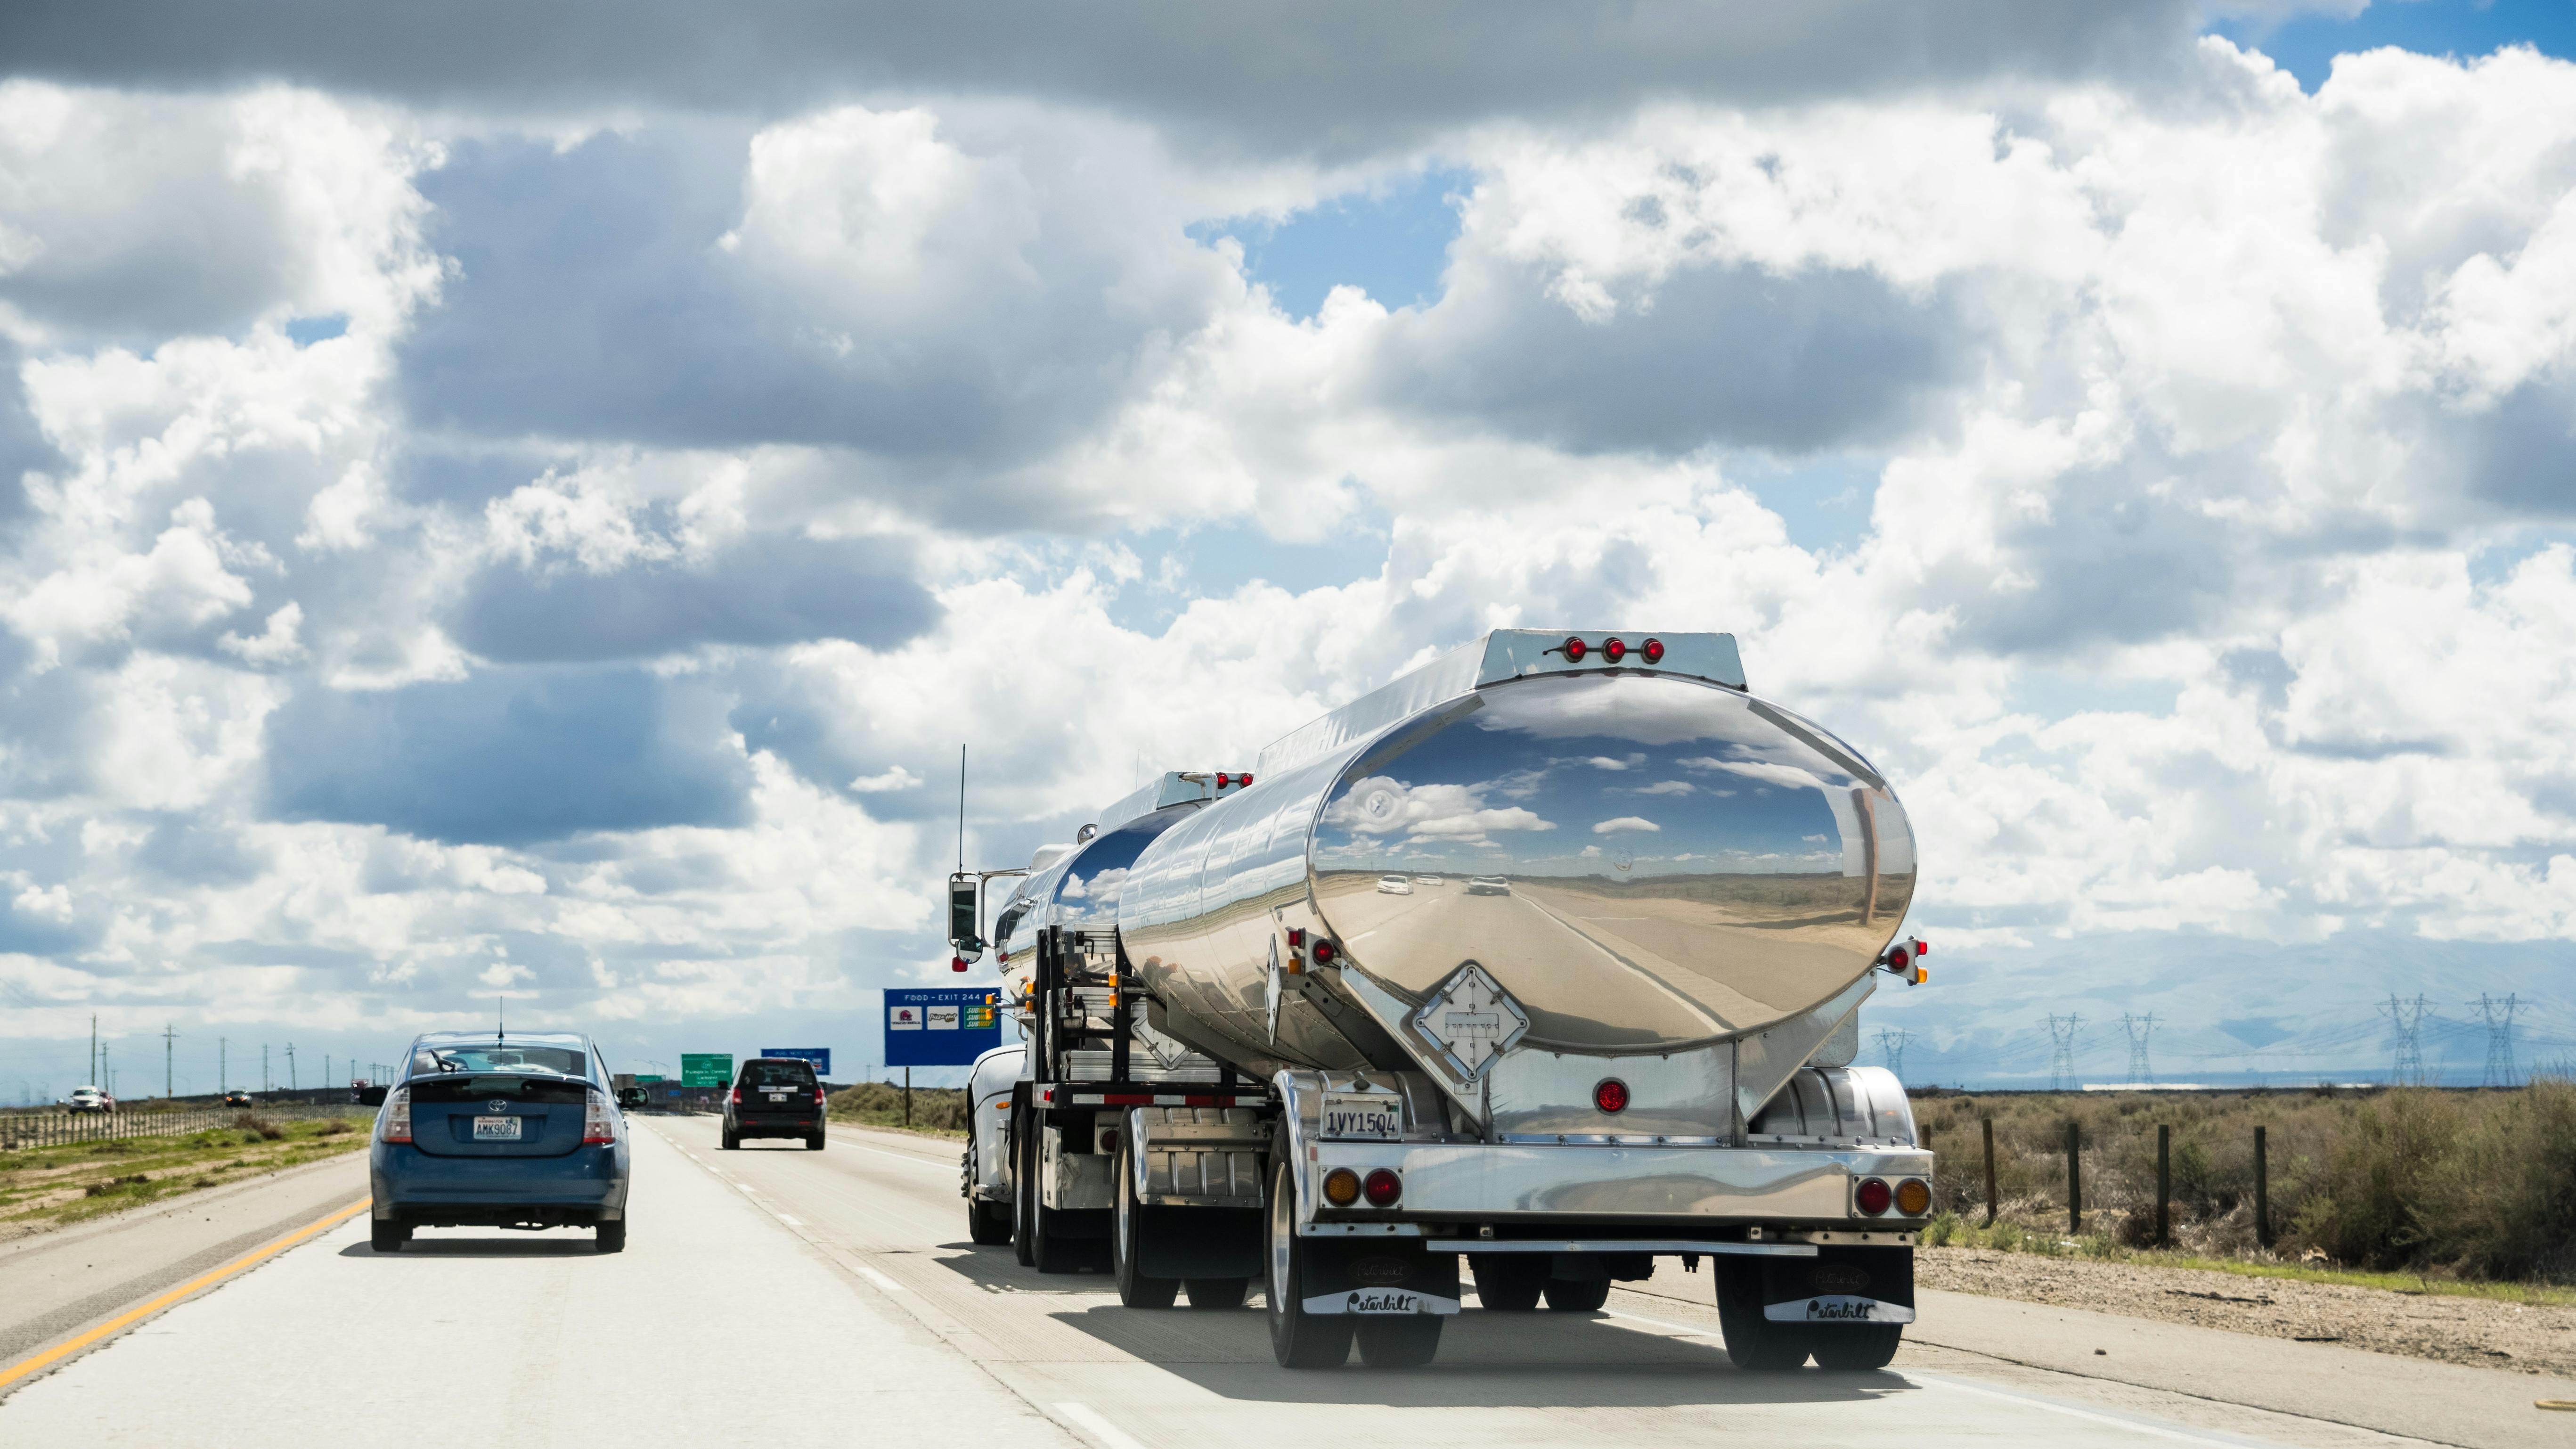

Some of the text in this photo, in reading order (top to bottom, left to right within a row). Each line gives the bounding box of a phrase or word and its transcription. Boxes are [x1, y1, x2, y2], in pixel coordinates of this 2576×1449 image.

[476, 1124, 517, 1135] AMK9087
[1357, 1262, 1407, 1277] Peterbilt
[1815, 1270, 1864, 1285] Peterbilt
[1346, 1292, 1417, 1312] Peterbilt
[1806, 1299, 1875, 1320] Peterbilt
